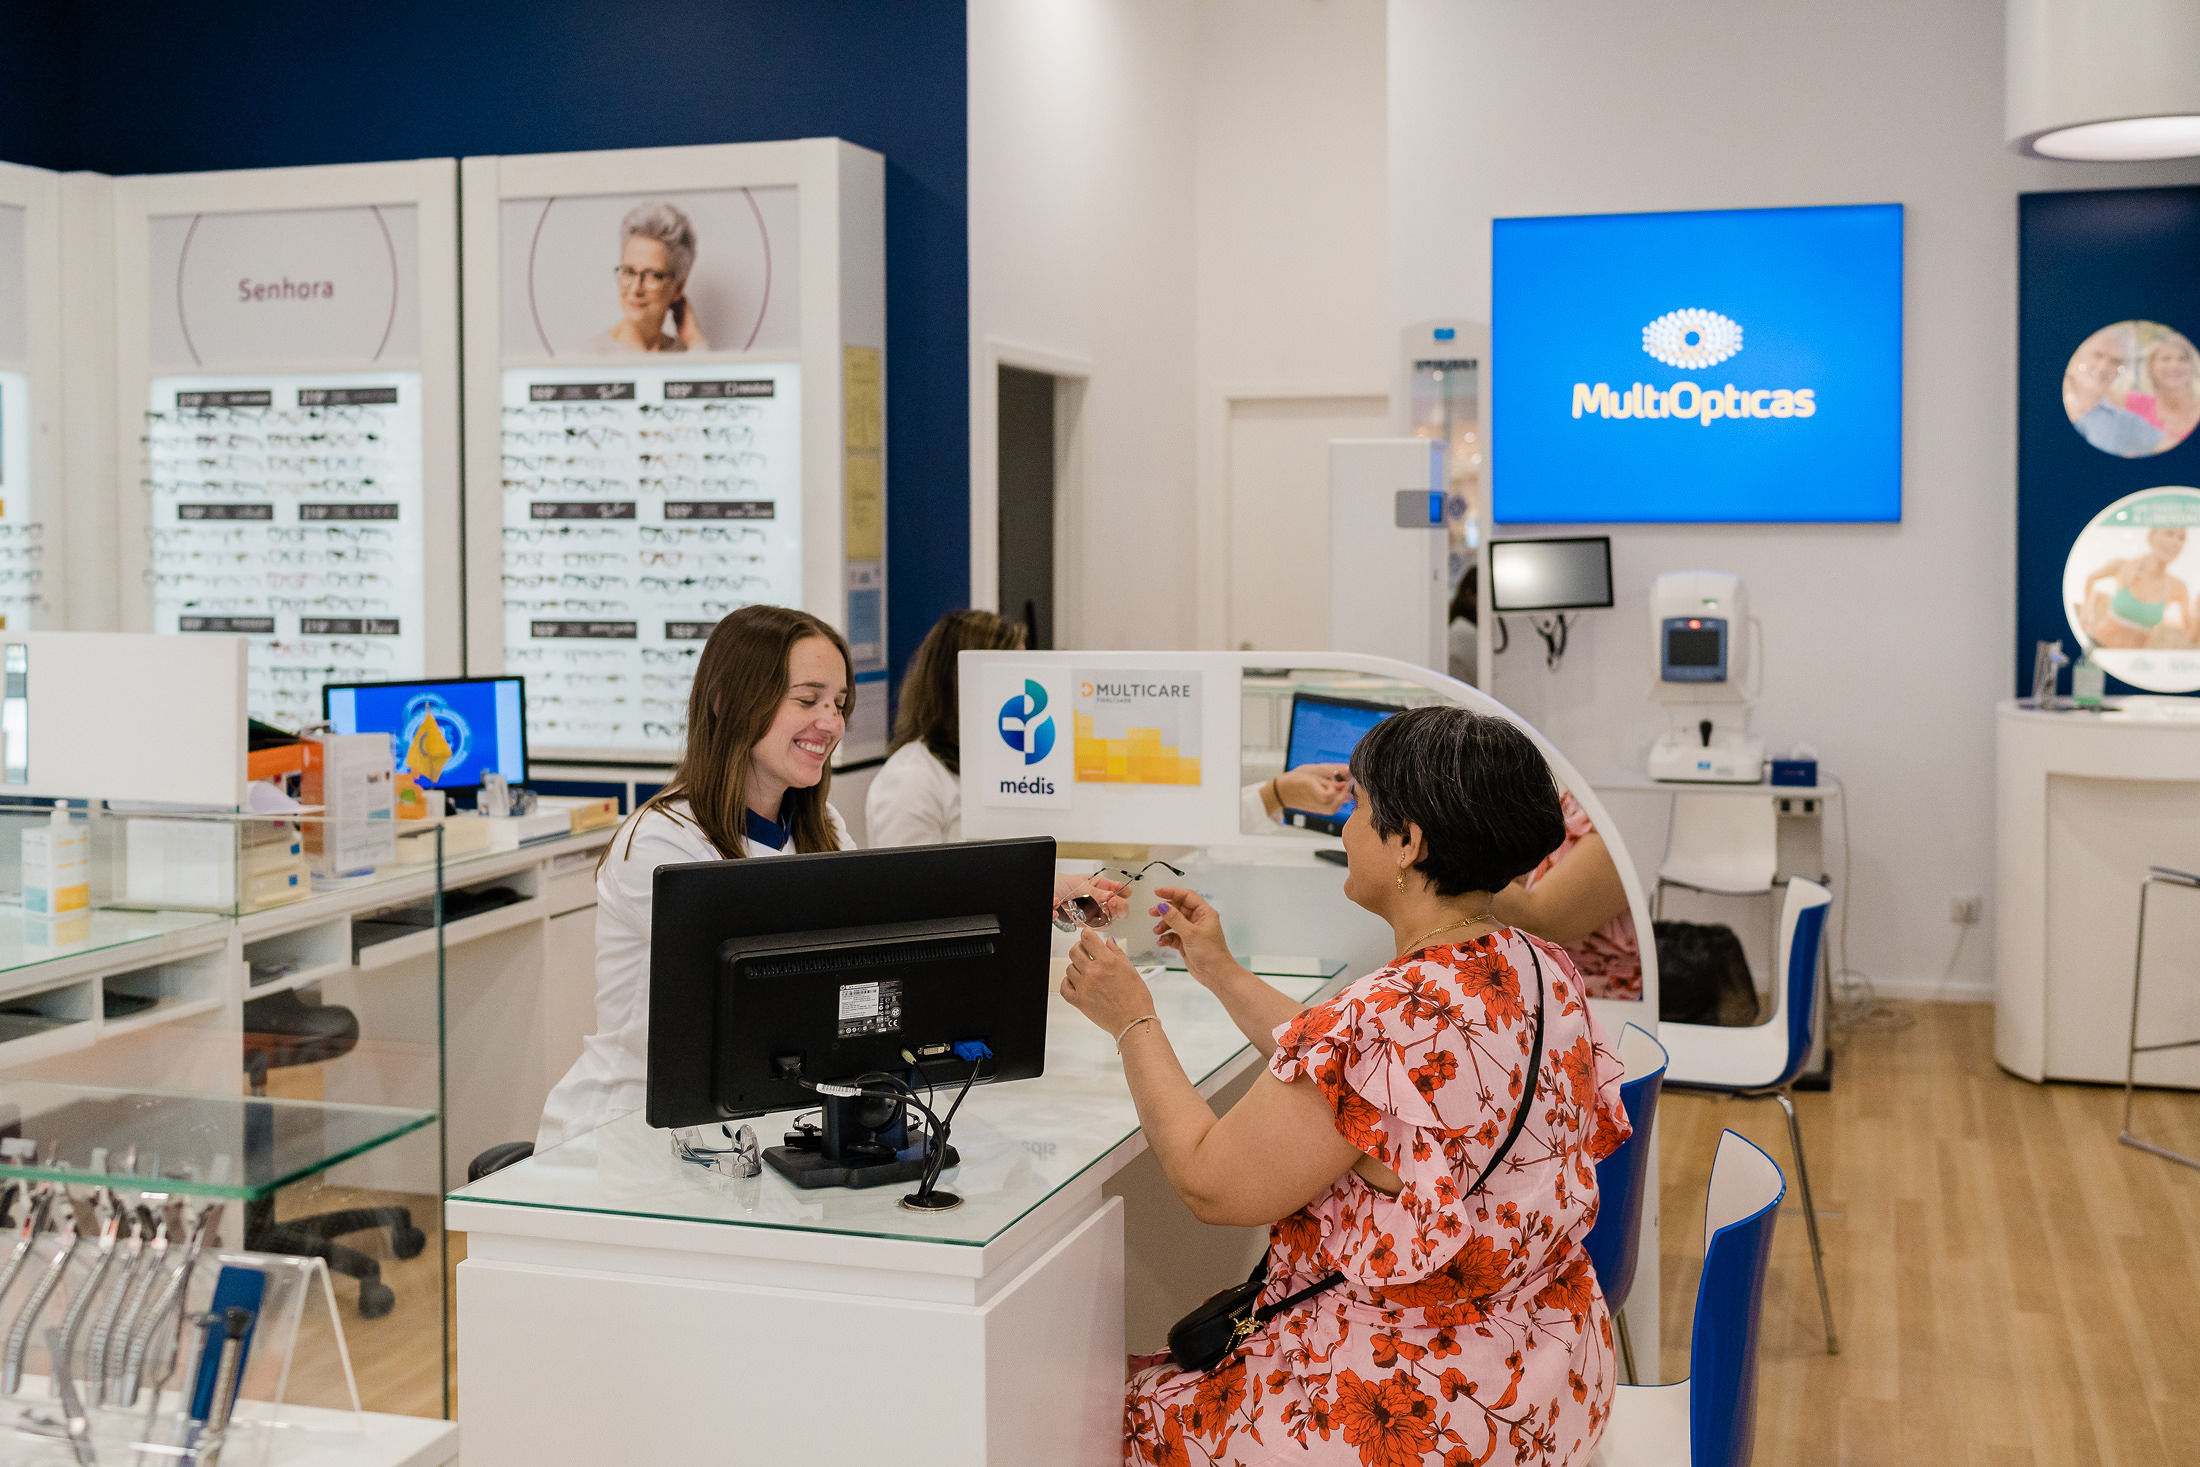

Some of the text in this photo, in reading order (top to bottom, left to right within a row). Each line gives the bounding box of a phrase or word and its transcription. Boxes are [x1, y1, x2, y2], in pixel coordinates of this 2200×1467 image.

[239, 277, 334, 302] Senhora
[1572, 382, 1816, 427] MultiOpticas
[1096, 683, 1191, 698] MULTICARE
[1000, 776, 1055, 795] médis
